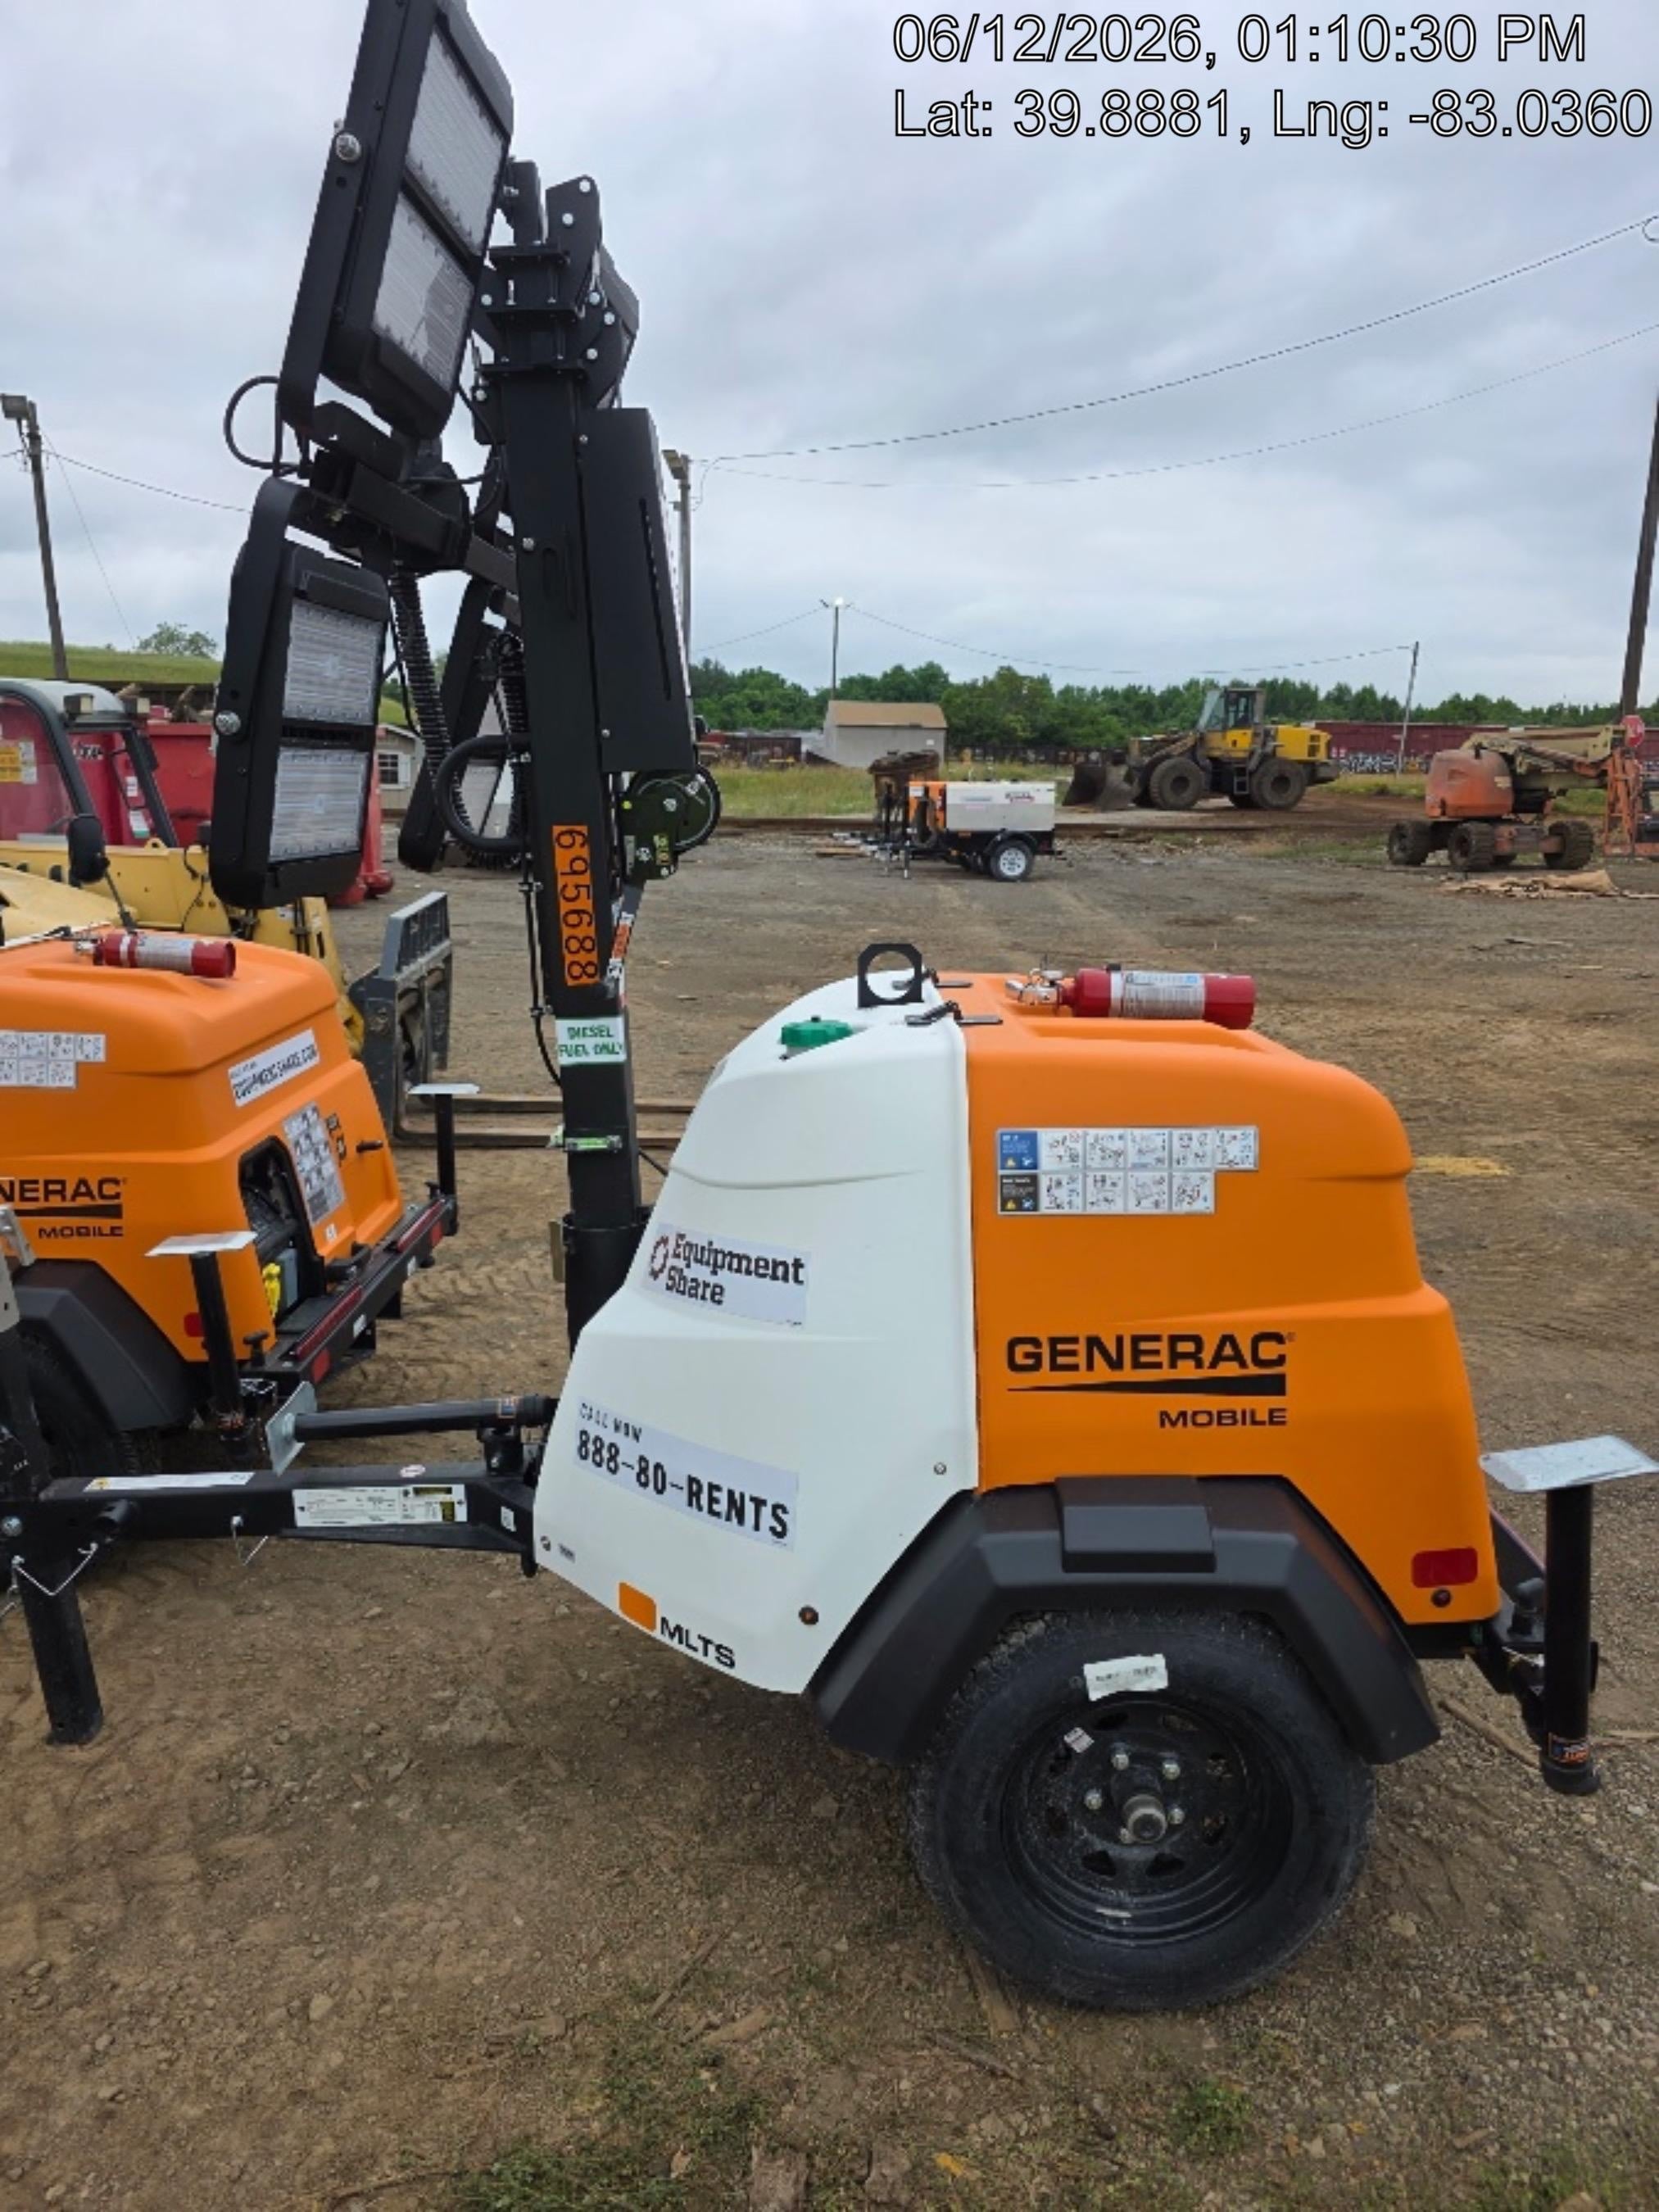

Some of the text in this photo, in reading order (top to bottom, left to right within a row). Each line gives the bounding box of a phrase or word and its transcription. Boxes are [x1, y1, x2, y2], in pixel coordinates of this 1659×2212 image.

[555, 829, 599, 981] 695688
[557, 1041, 623, 1058] FUEL ONLY
[566, 1024, 614, 1040] DIESEL
[38, 1226, 124, 1239] MOBILE
[671, 1232, 805, 1285] Equipment
[665, 1265, 724, 1306] Share
[1006, 1331, 1286, 1372] GENERAC
[579, 1402, 608, 1429] CALL
[1159, 1407, 1287, 1428] MOBILE
[577, 1429, 790, 1539] 888-80-RENTS
[660, 1616, 736, 1670] MLTS
